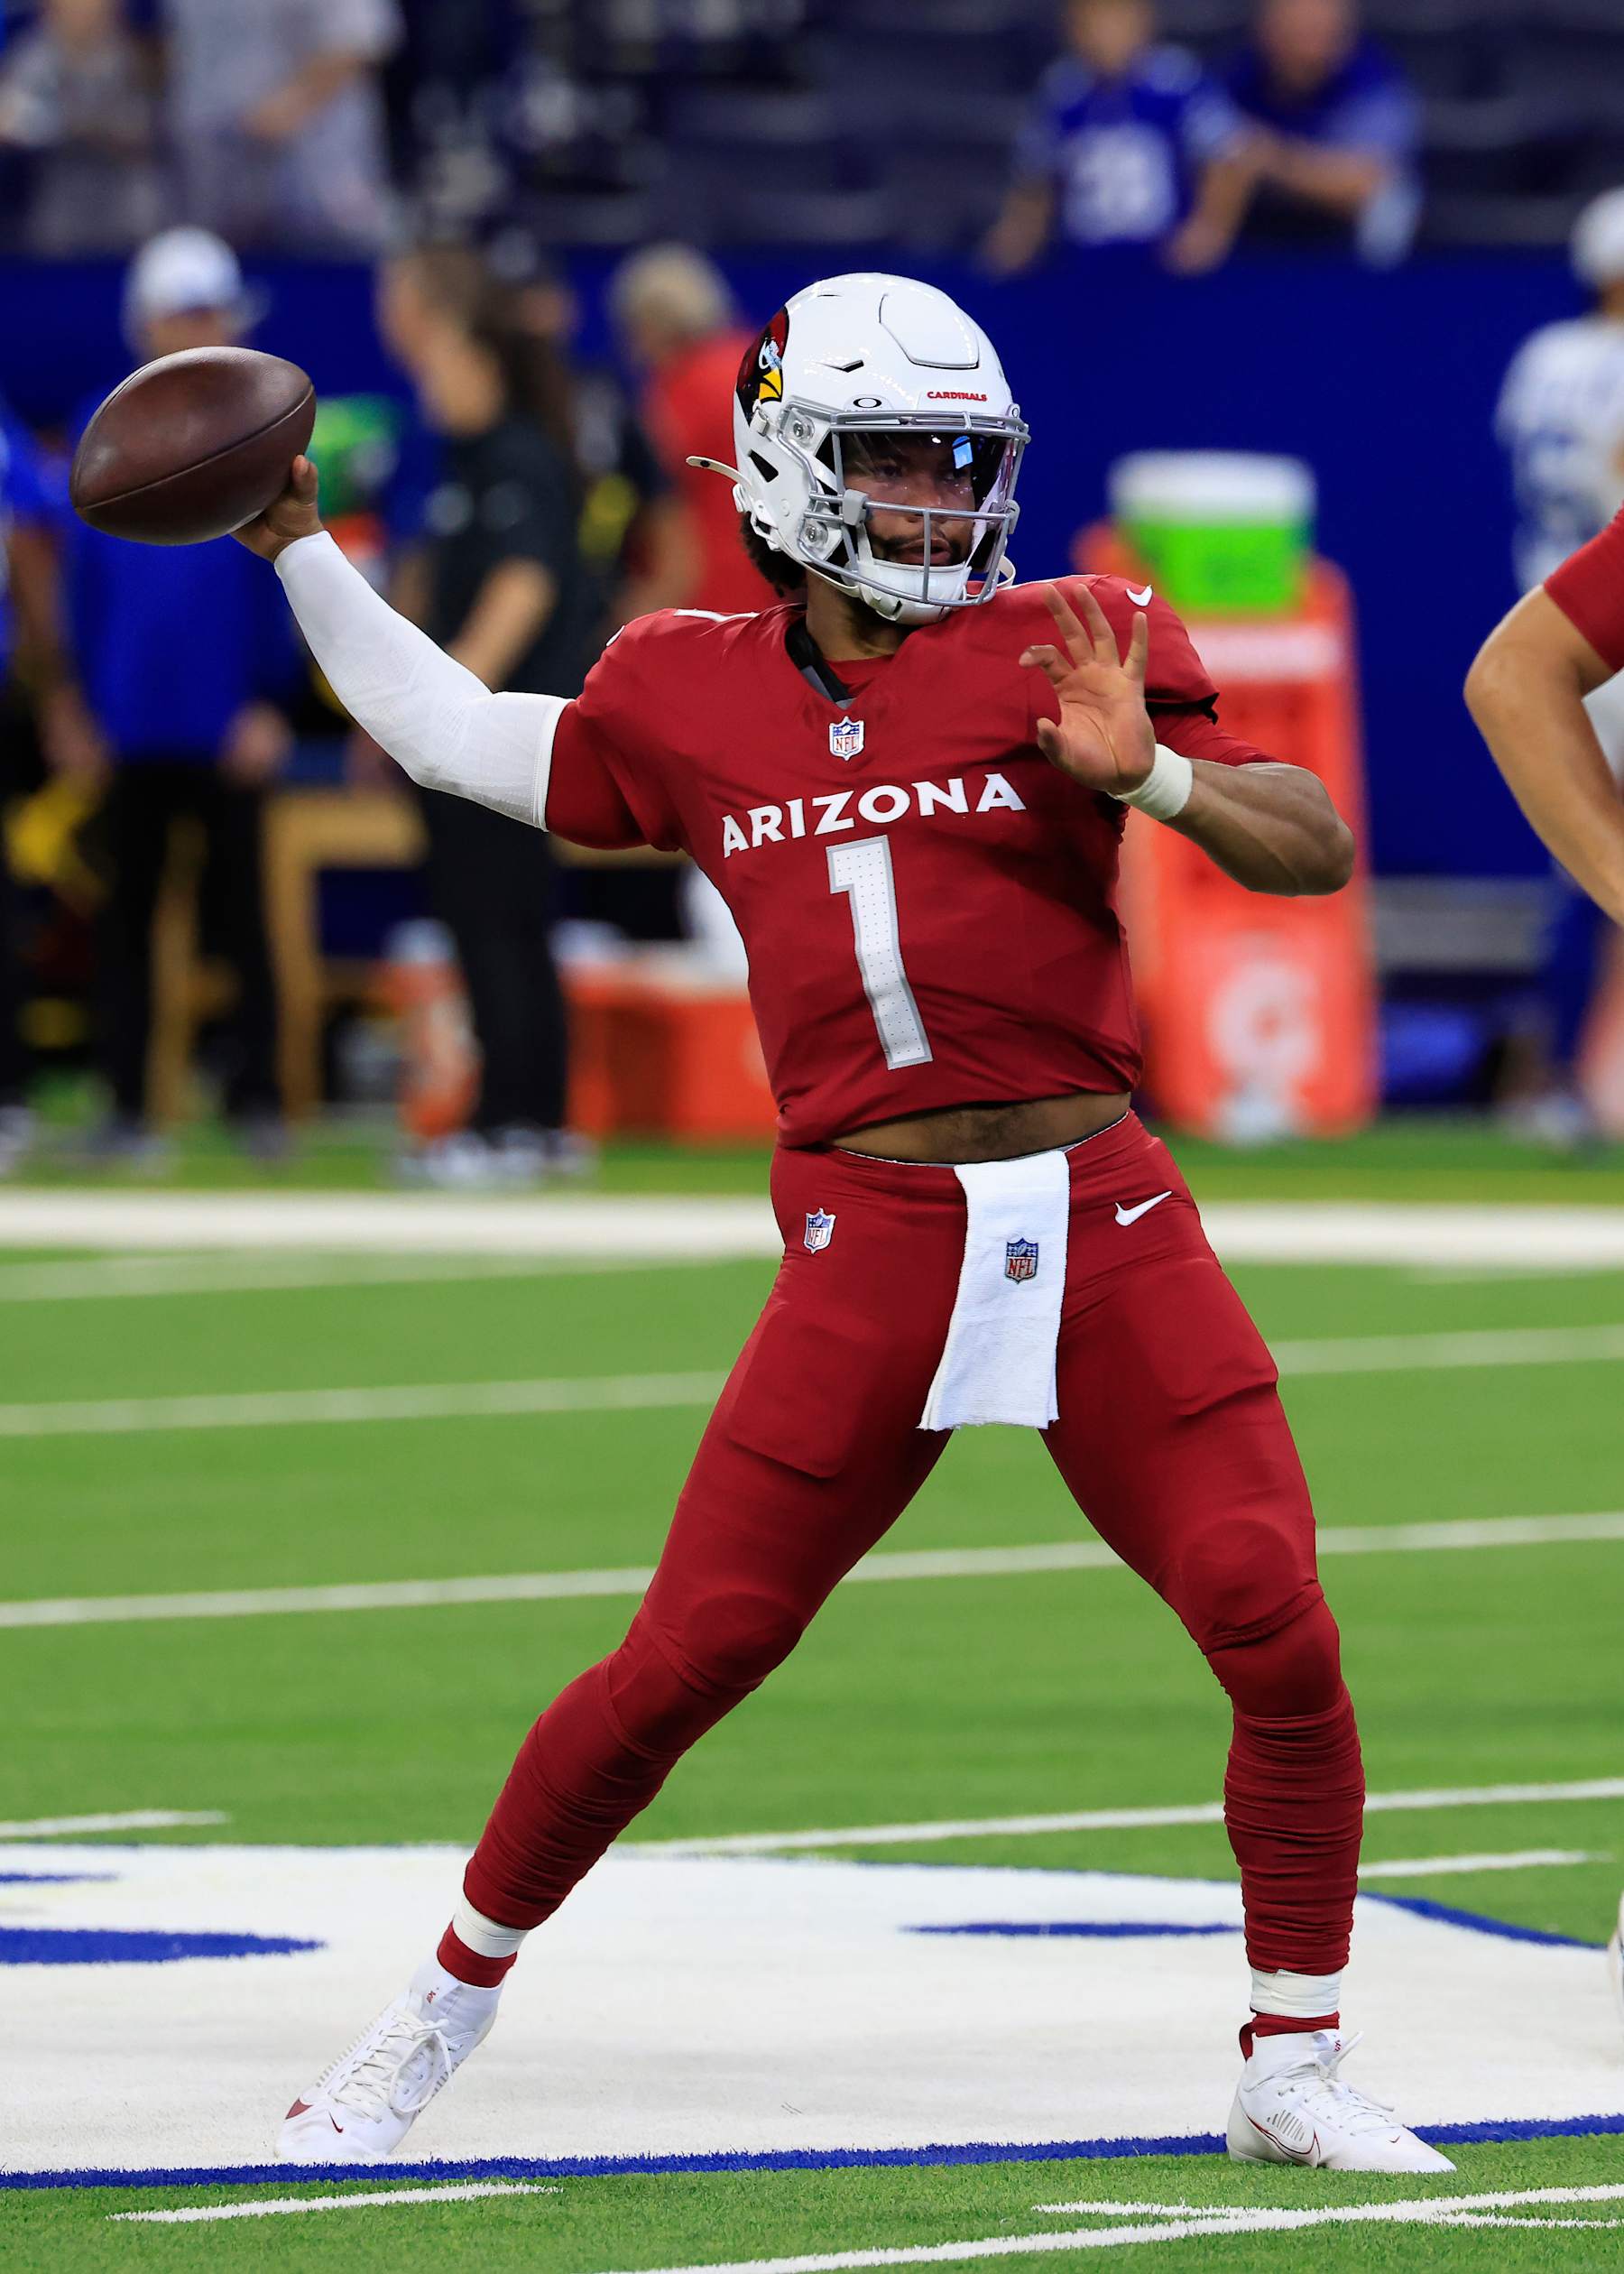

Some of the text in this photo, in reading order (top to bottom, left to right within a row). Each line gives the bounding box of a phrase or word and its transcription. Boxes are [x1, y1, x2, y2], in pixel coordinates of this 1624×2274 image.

[927, 391, 988, 402] CARDINALS
[835, 735, 857, 752] NFL
[722, 773, 1027, 858] ARIZONA
[826, 835, 934, 1071] 1
[807, 1228, 826, 1245] NFL
[1008, 1258, 1034, 1278] NFL
